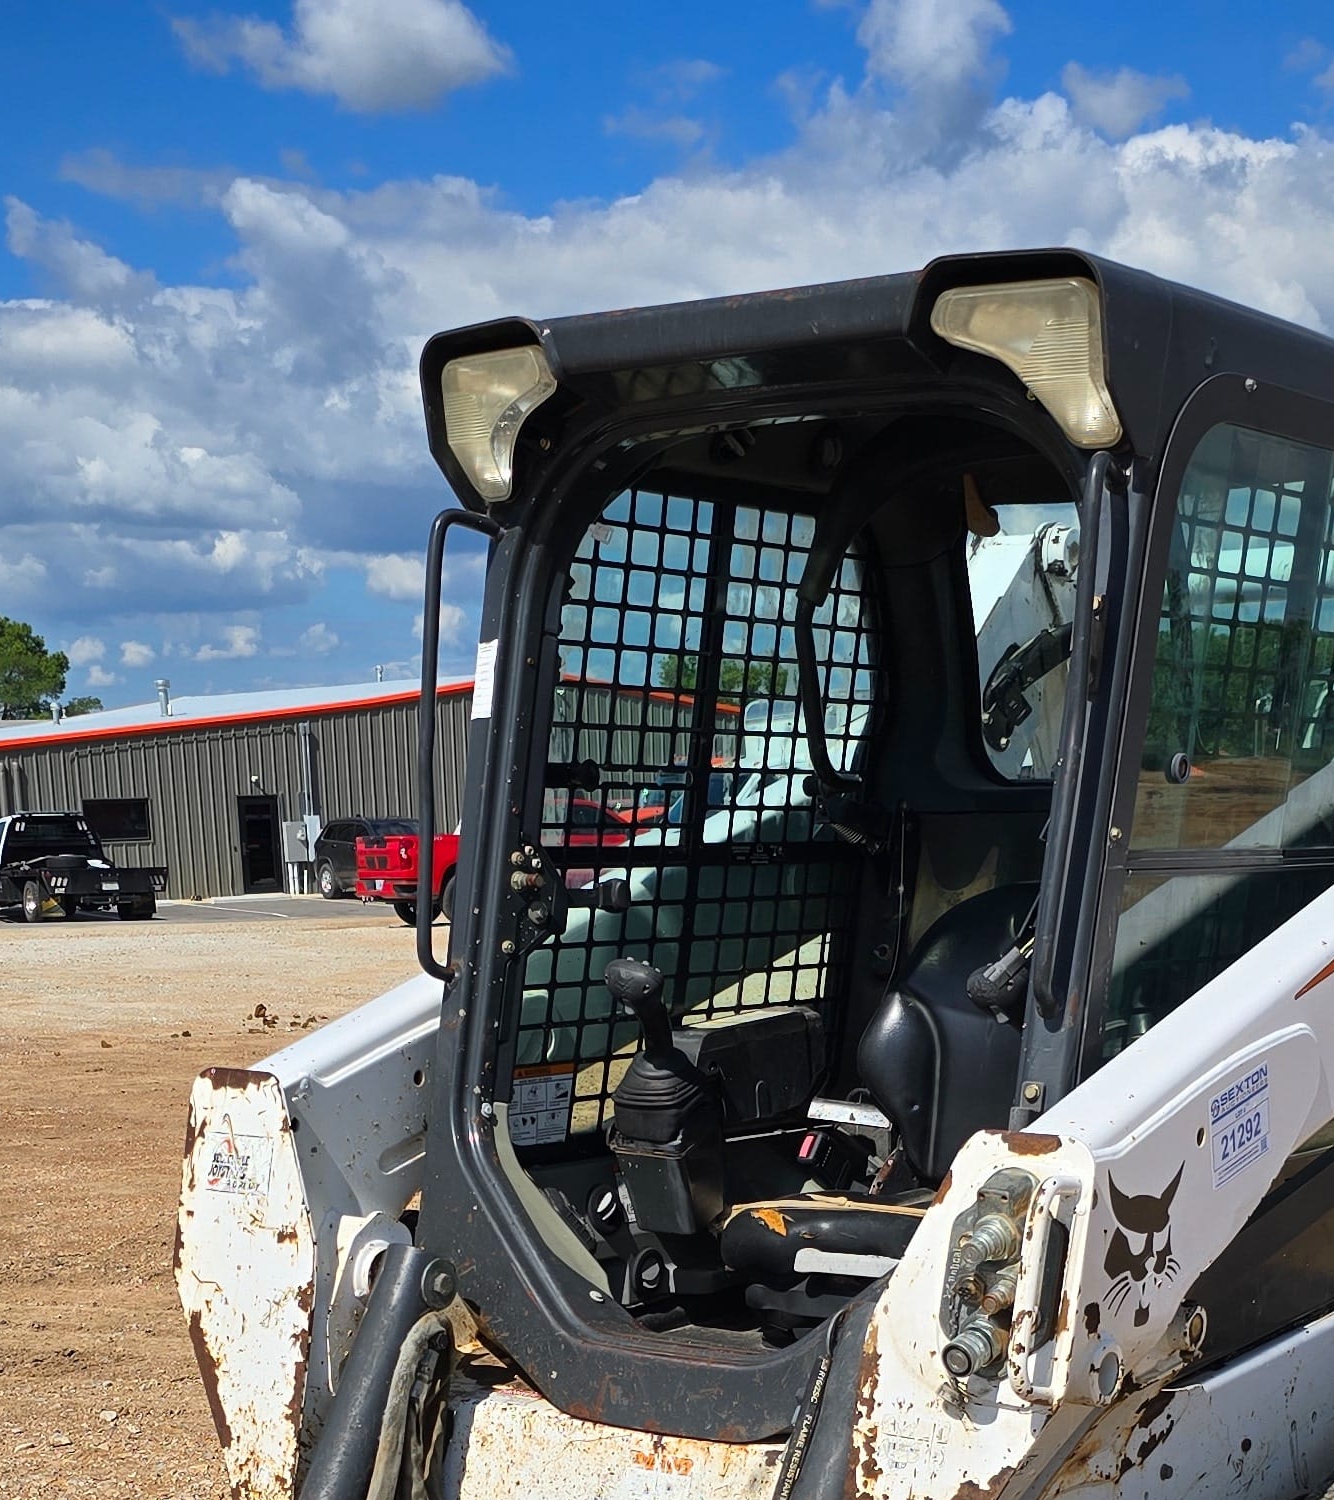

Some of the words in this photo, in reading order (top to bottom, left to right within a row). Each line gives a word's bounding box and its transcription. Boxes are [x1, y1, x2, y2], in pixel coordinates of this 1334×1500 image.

[1220, 1064, 1268, 1106] SEXTON
[1220, 1112, 1261, 1160] 21292
[796, 1414, 813, 1449] FLAME
